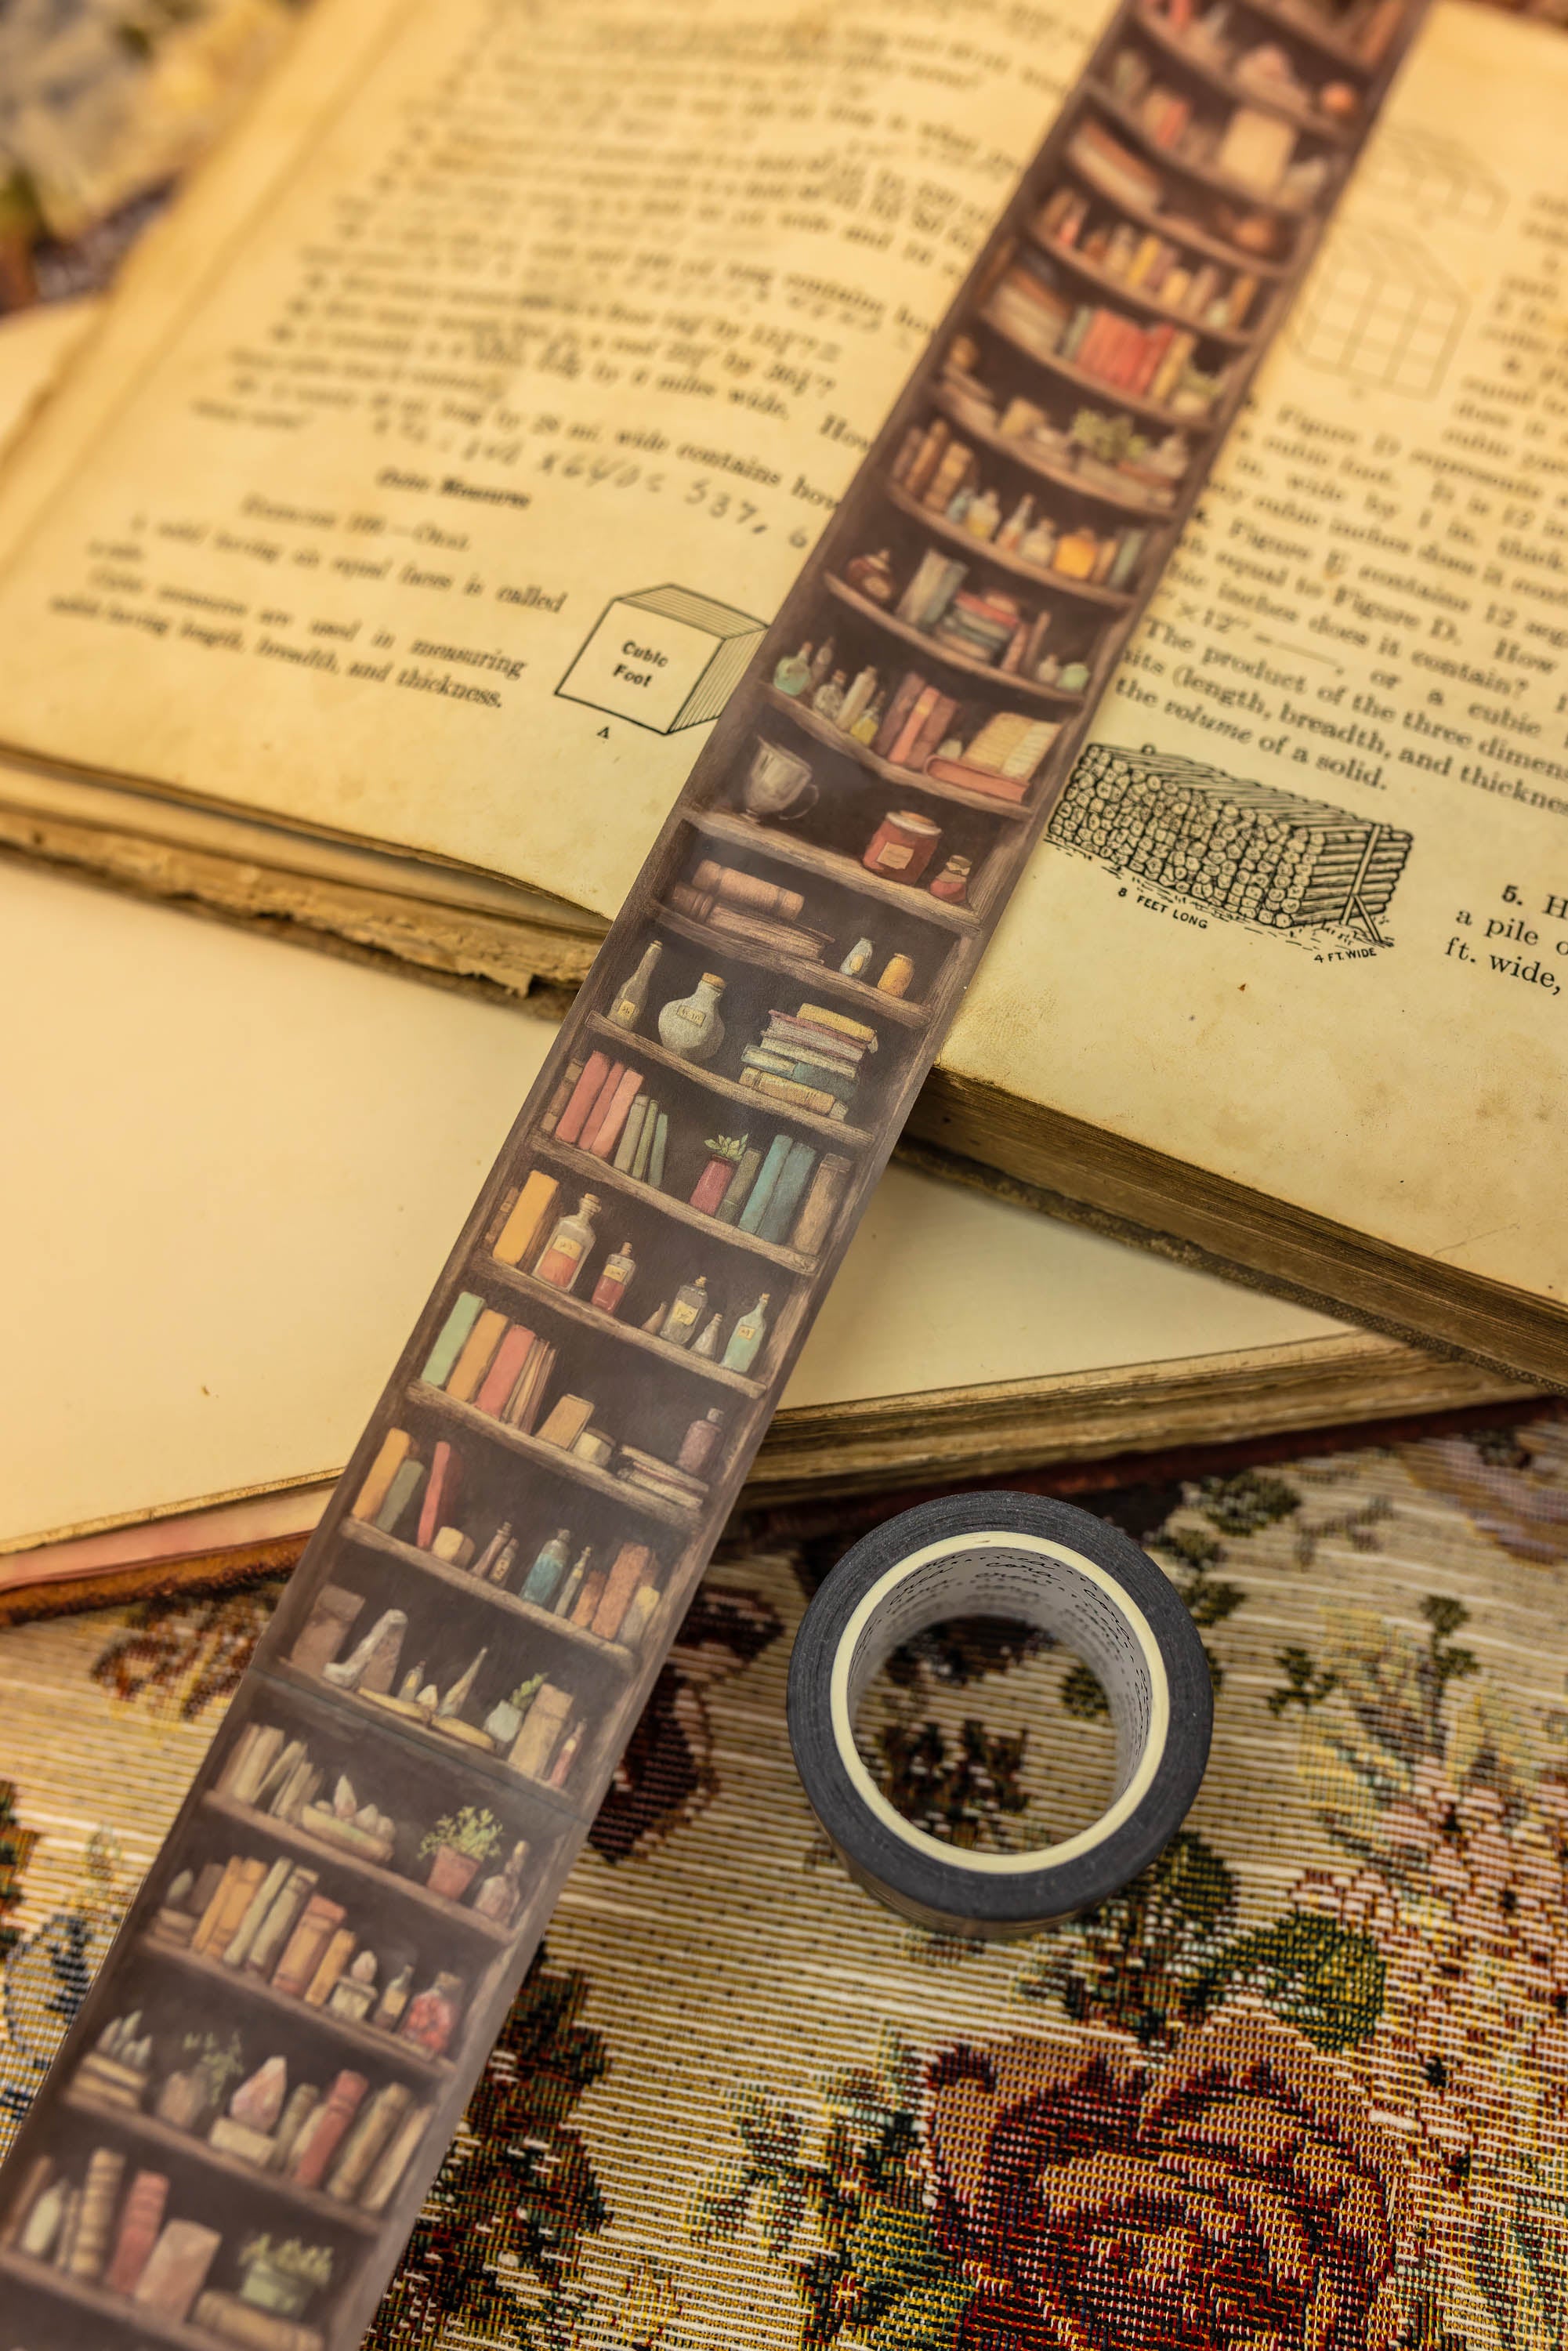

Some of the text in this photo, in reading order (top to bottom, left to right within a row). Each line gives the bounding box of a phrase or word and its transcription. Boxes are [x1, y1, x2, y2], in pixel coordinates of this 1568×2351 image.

[621, 640, 669, 668] Cubic
[395, 664, 504, 708] thickness.
[612, 664, 653, 688] Foot
[1201, 644, 1309, 695] product
[1316, 683, 1347, 707] of
[1352, 691, 1396, 723] the
[1401, 709, 1473, 749] three
[596, 725, 611, 740] A
[1114, 676, 1388, 791] the volume of a solid.
[1426, 686, 1445, 706] a
[1467, 701, 1541, 738] cubic
[1278, 698, 1392, 761] breadth,
[1397, 745, 1454, 777] and
[1118, 887, 1208, 930] 8 FEET LONG
[1500, 883, 1524, 907] 5.
[1455, 909, 1473, 926] a
[1483, 917, 1540, 947] pile
[1314, 954, 1324, 963] 4
[1345, 947, 1378, 960] WIDE
[1443, 936, 1562, 996] ft. wide,
